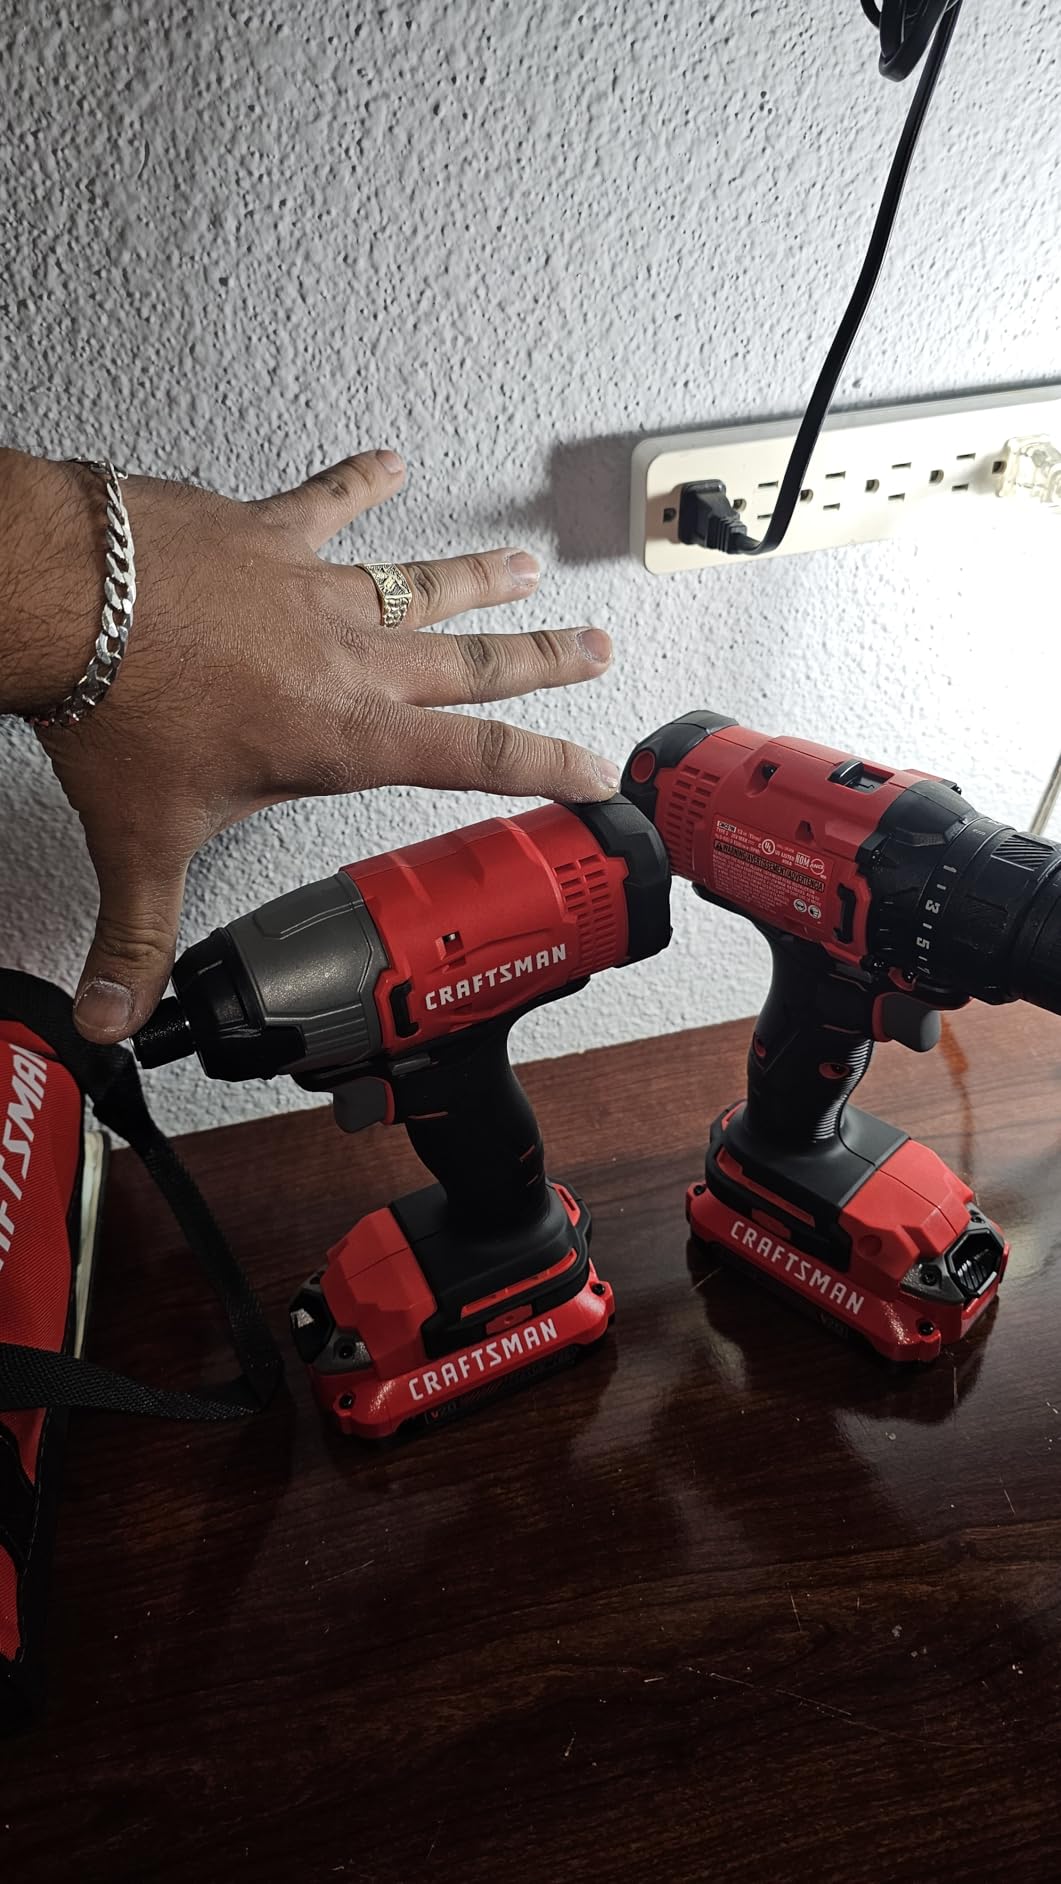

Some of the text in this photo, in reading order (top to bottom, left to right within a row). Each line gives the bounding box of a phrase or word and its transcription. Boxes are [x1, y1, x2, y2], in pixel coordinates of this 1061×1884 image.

[795, 853, 810, 868] NOM
[925, 899, 941, 915] 3
[916, 936, 931, 950] 5
[425, 943, 567, 1010] CRAFTSMAN
[729, 1220, 865, 1315] CRAFTSMAN
[408, 1318, 558, 1401] CRAFTSMAN
